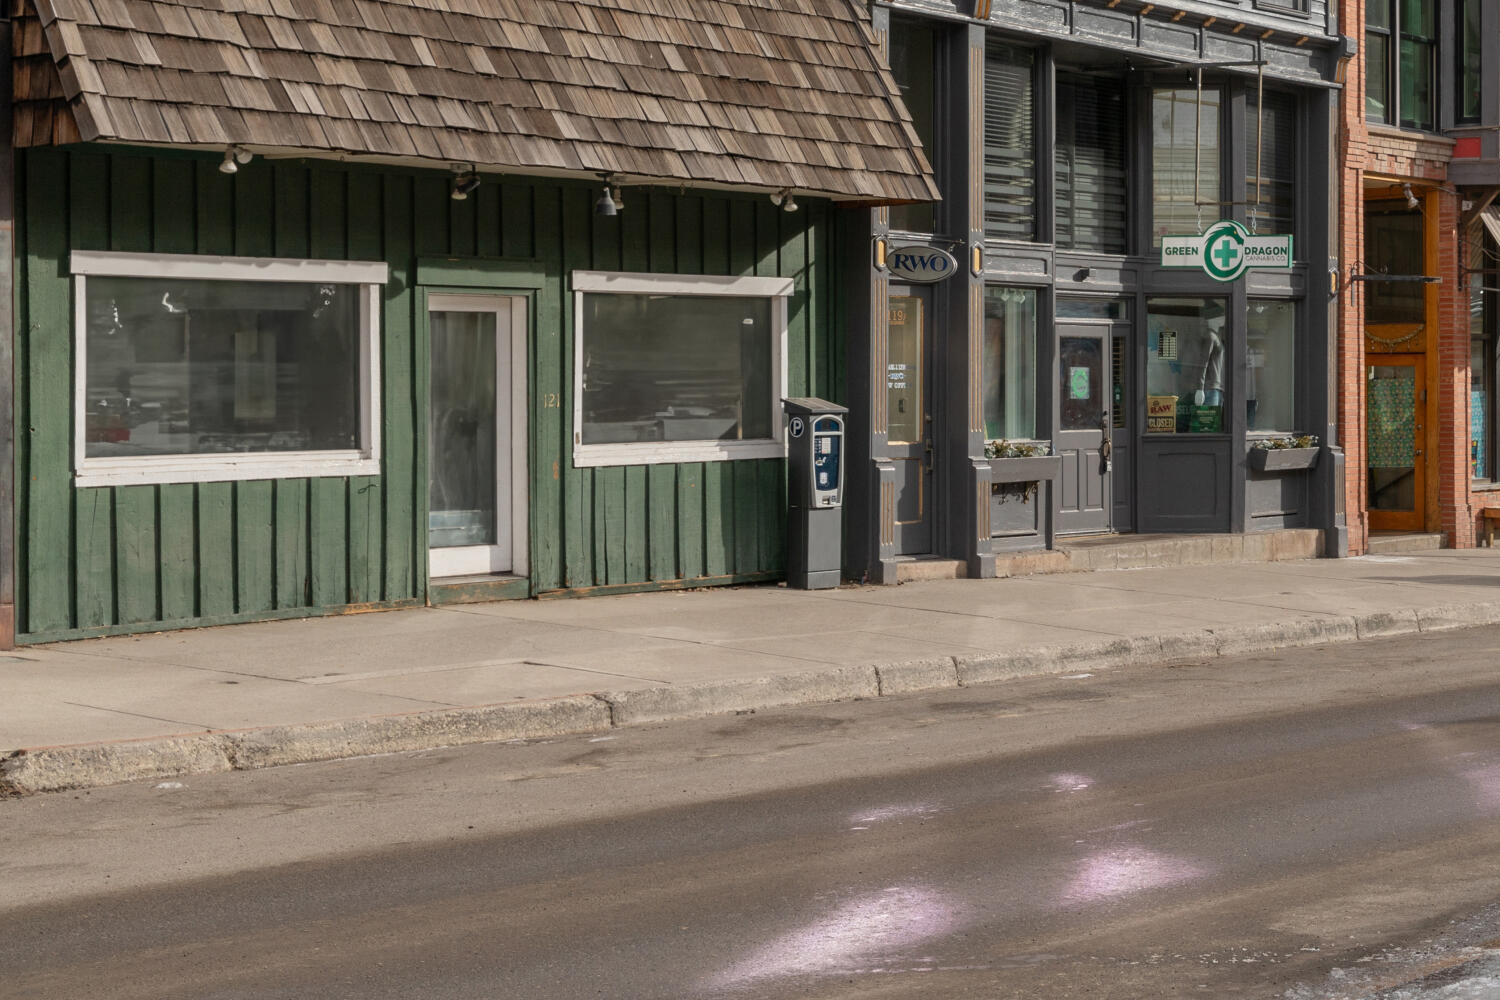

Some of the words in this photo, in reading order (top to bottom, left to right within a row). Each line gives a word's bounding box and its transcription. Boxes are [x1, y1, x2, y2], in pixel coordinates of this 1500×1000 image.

[1165, 247, 1199, 255] GREEN
[1244, 247, 1287, 255] DRAGON
[894, 254, 948, 272] RWO
[544, 393, 560, 408] 121
[1150, 404, 1172, 415] RAW
[1148, 418, 1174, 428] CLOSED
